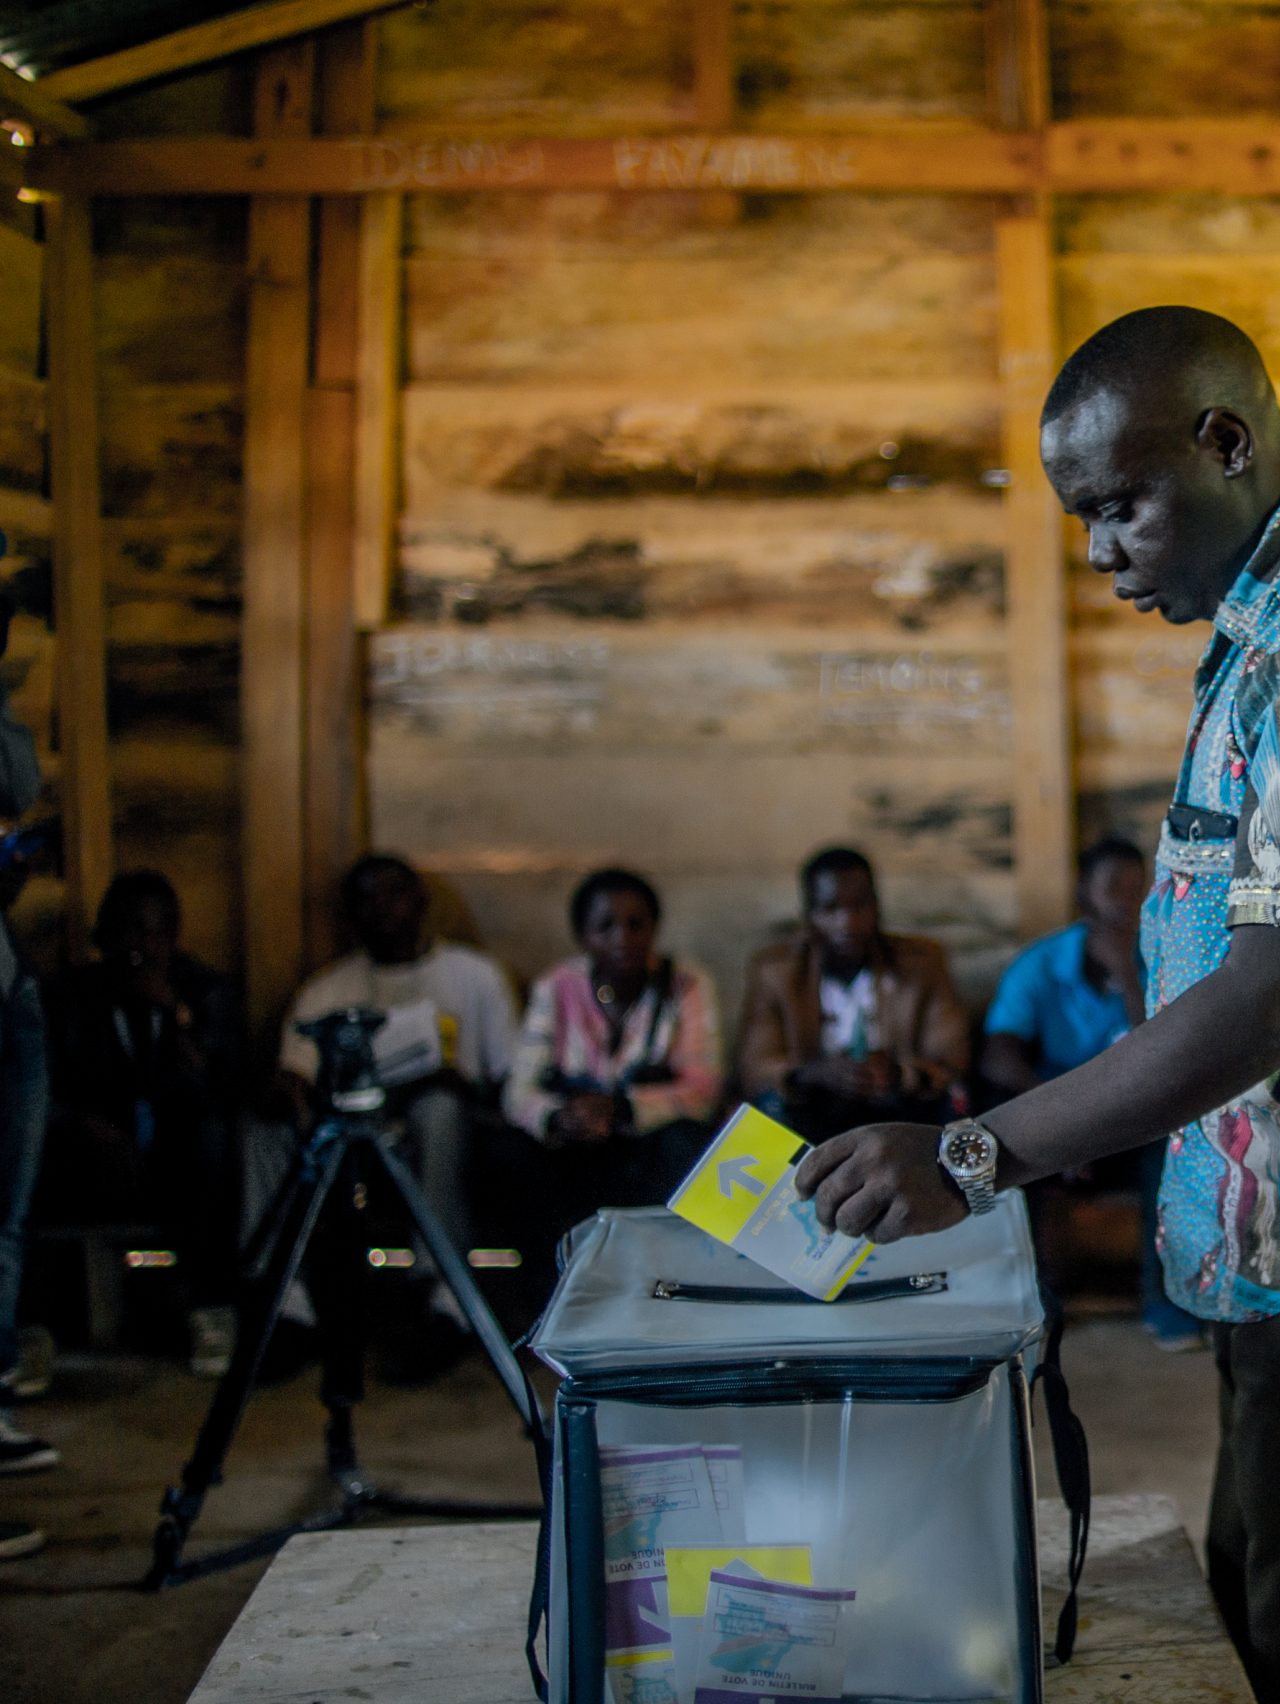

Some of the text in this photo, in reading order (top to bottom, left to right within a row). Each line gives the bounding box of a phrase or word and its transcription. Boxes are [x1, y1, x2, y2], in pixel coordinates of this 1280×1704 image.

[750, 1669, 792, 1681] UNIQUE
[722, 1674, 817, 1692] BULLETIN DE VOTE
